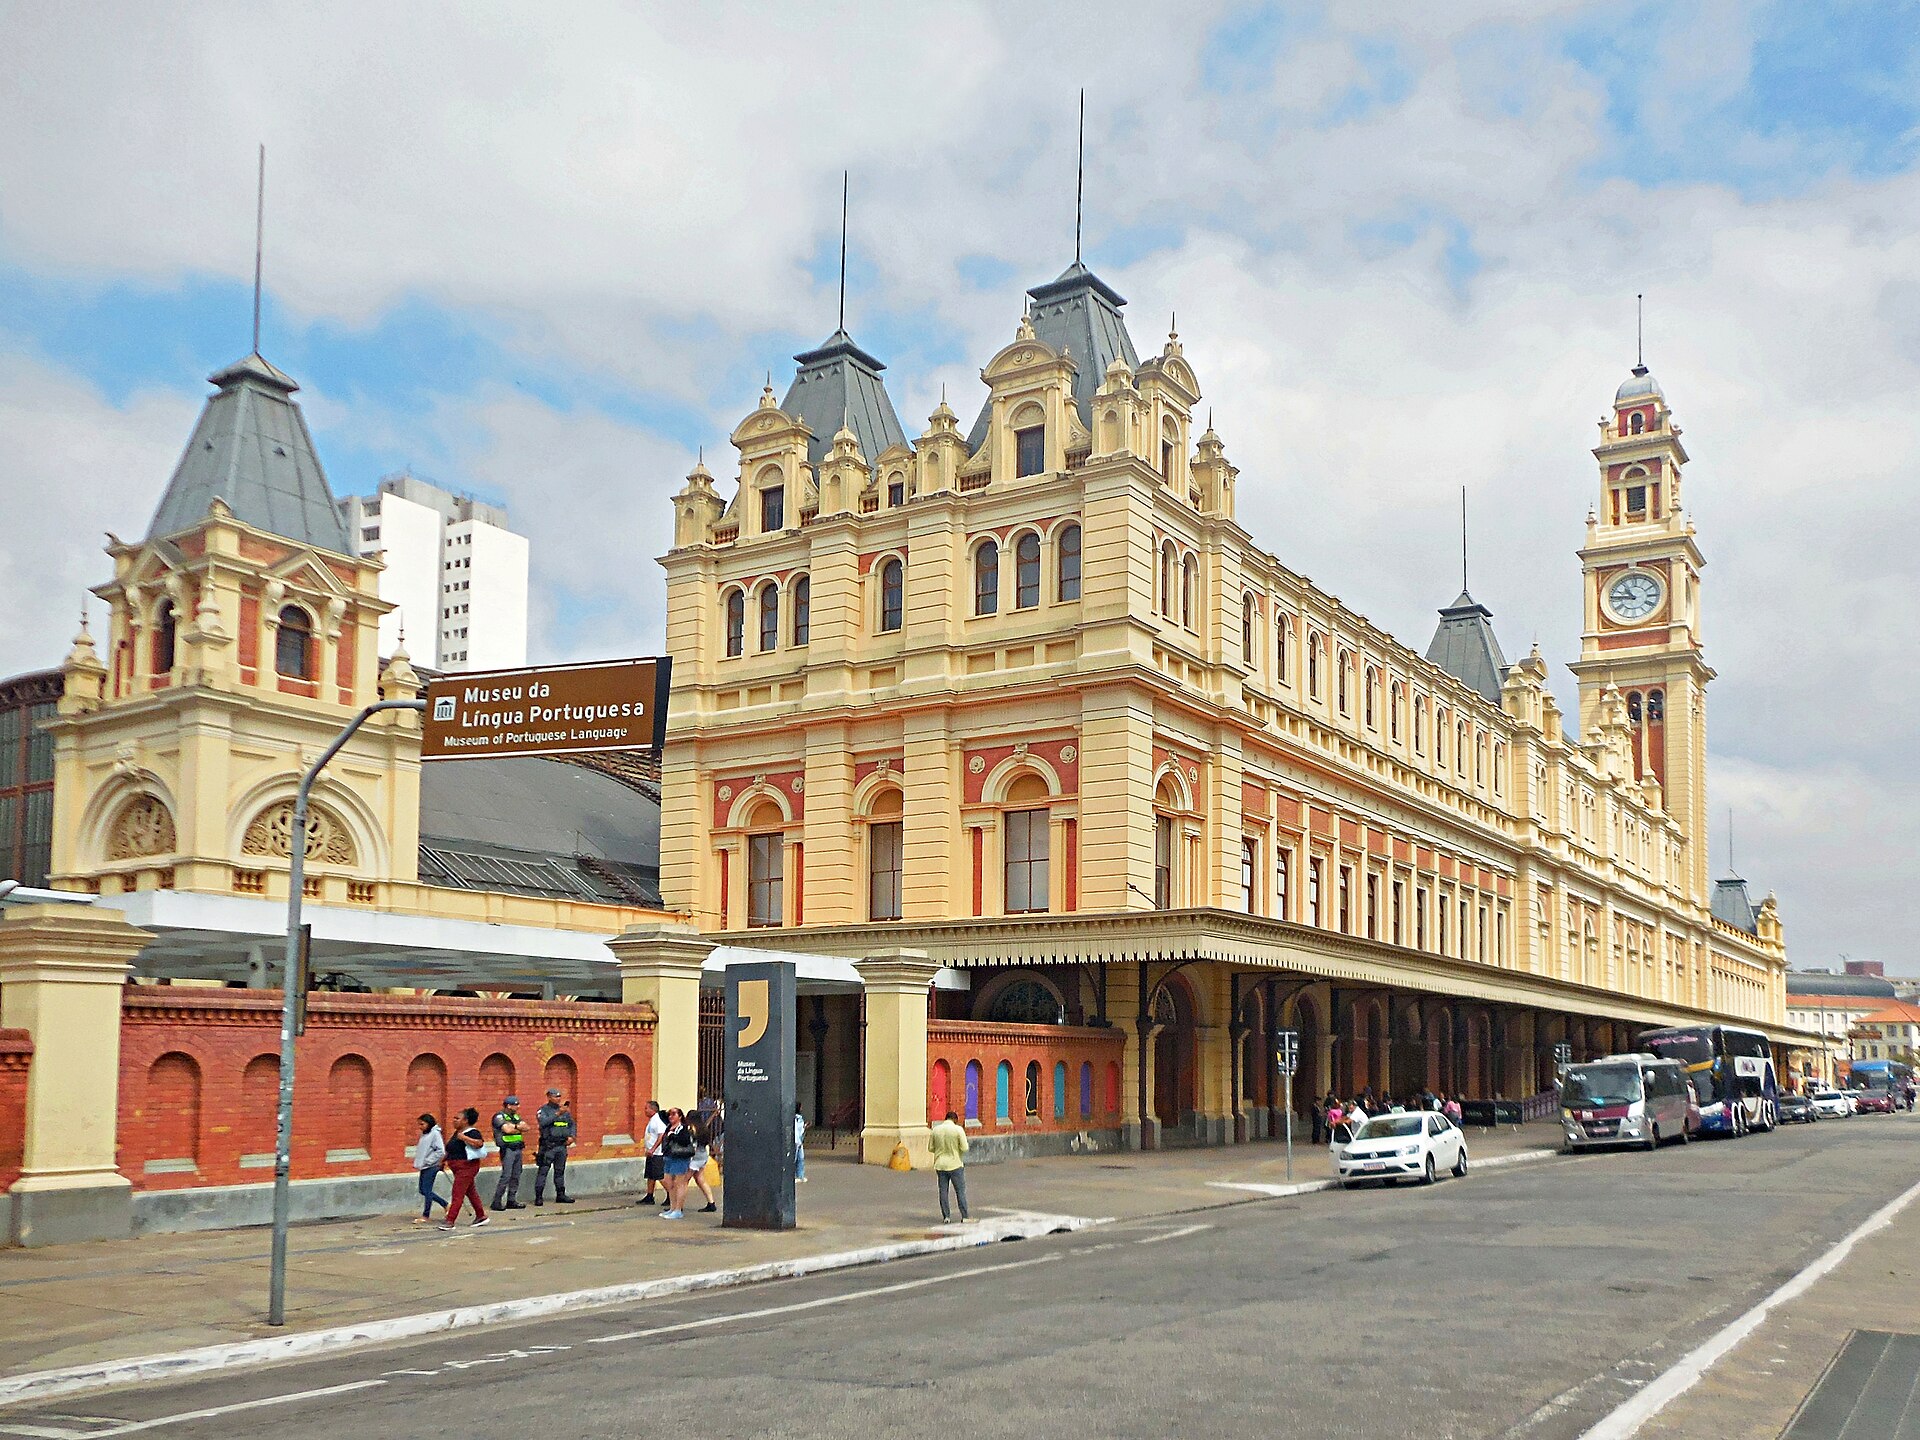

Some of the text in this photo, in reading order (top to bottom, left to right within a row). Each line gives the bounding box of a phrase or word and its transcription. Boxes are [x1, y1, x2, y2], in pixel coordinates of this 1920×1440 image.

[464, 681, 550, 704] Museu da
[462, 702, 644, 729] Língua Portuguesa
[444, 728, 628, 747] Museum of Portuguese Language
[737, 1074, 769, 1083] Portuguesa
